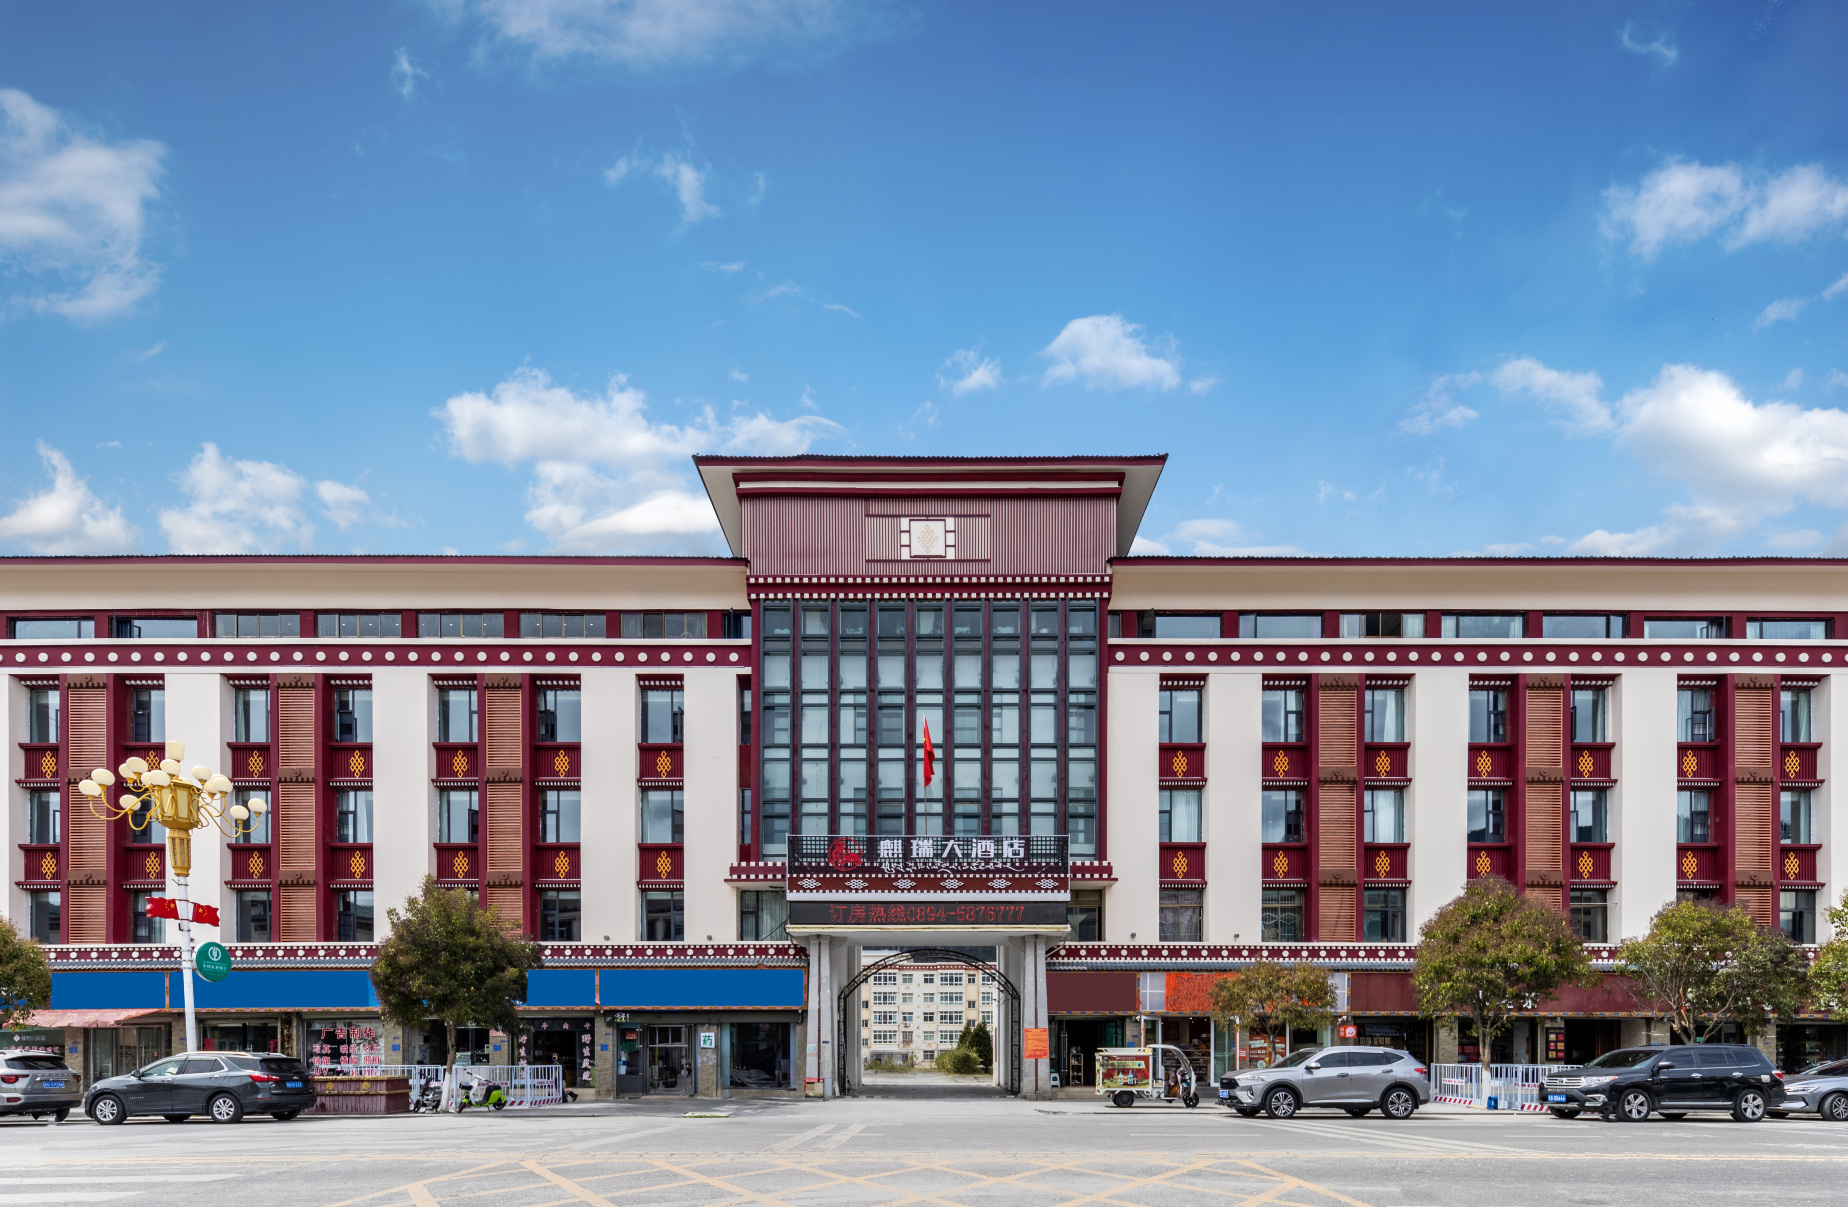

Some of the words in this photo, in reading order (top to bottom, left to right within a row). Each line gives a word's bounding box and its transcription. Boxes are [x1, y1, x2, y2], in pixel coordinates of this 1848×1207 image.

[879, 838, 1026, 858] 麒瑞大酒店
[321, 1027, 376, 1039] 广告制作
[702, 1035, 713, 1046] 药
[313, 1044, 331, 1054] 写真
[340, 1044, 358, 1054] 喷绘
[364, 1044, 379, 1053] 名片
[340, 1056, 358, 1065] 横幅
[364, 1056, 380, 1065] 照相
[314, 1068, 329, 1076] UV
